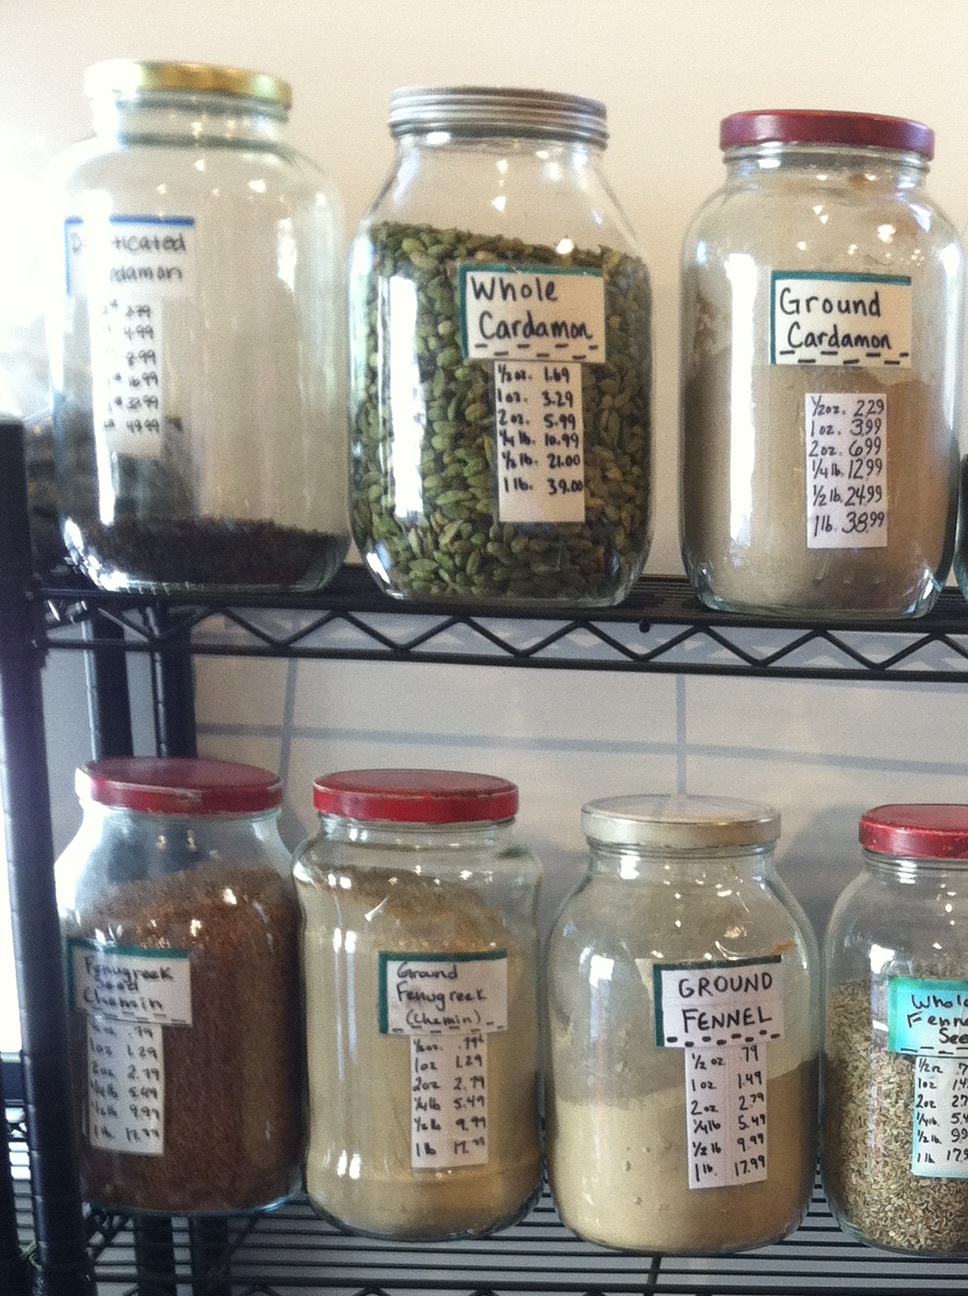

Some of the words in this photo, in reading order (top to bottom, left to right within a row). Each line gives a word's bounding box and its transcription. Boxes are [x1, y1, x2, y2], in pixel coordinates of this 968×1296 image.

[471, 276, 558, 301] Whole
[780, 287, 881, 317] Ground
[479, 311, 593, 340] Cardamon
[788, 321, 891, 349] Cardamon
[397, 962, 458, 979] Ground
[396, 981, 487, 1011] Fenugreek
[679, 972, 773, 998] GROUND
[682, 1006, 772, 1033] FENNEL
